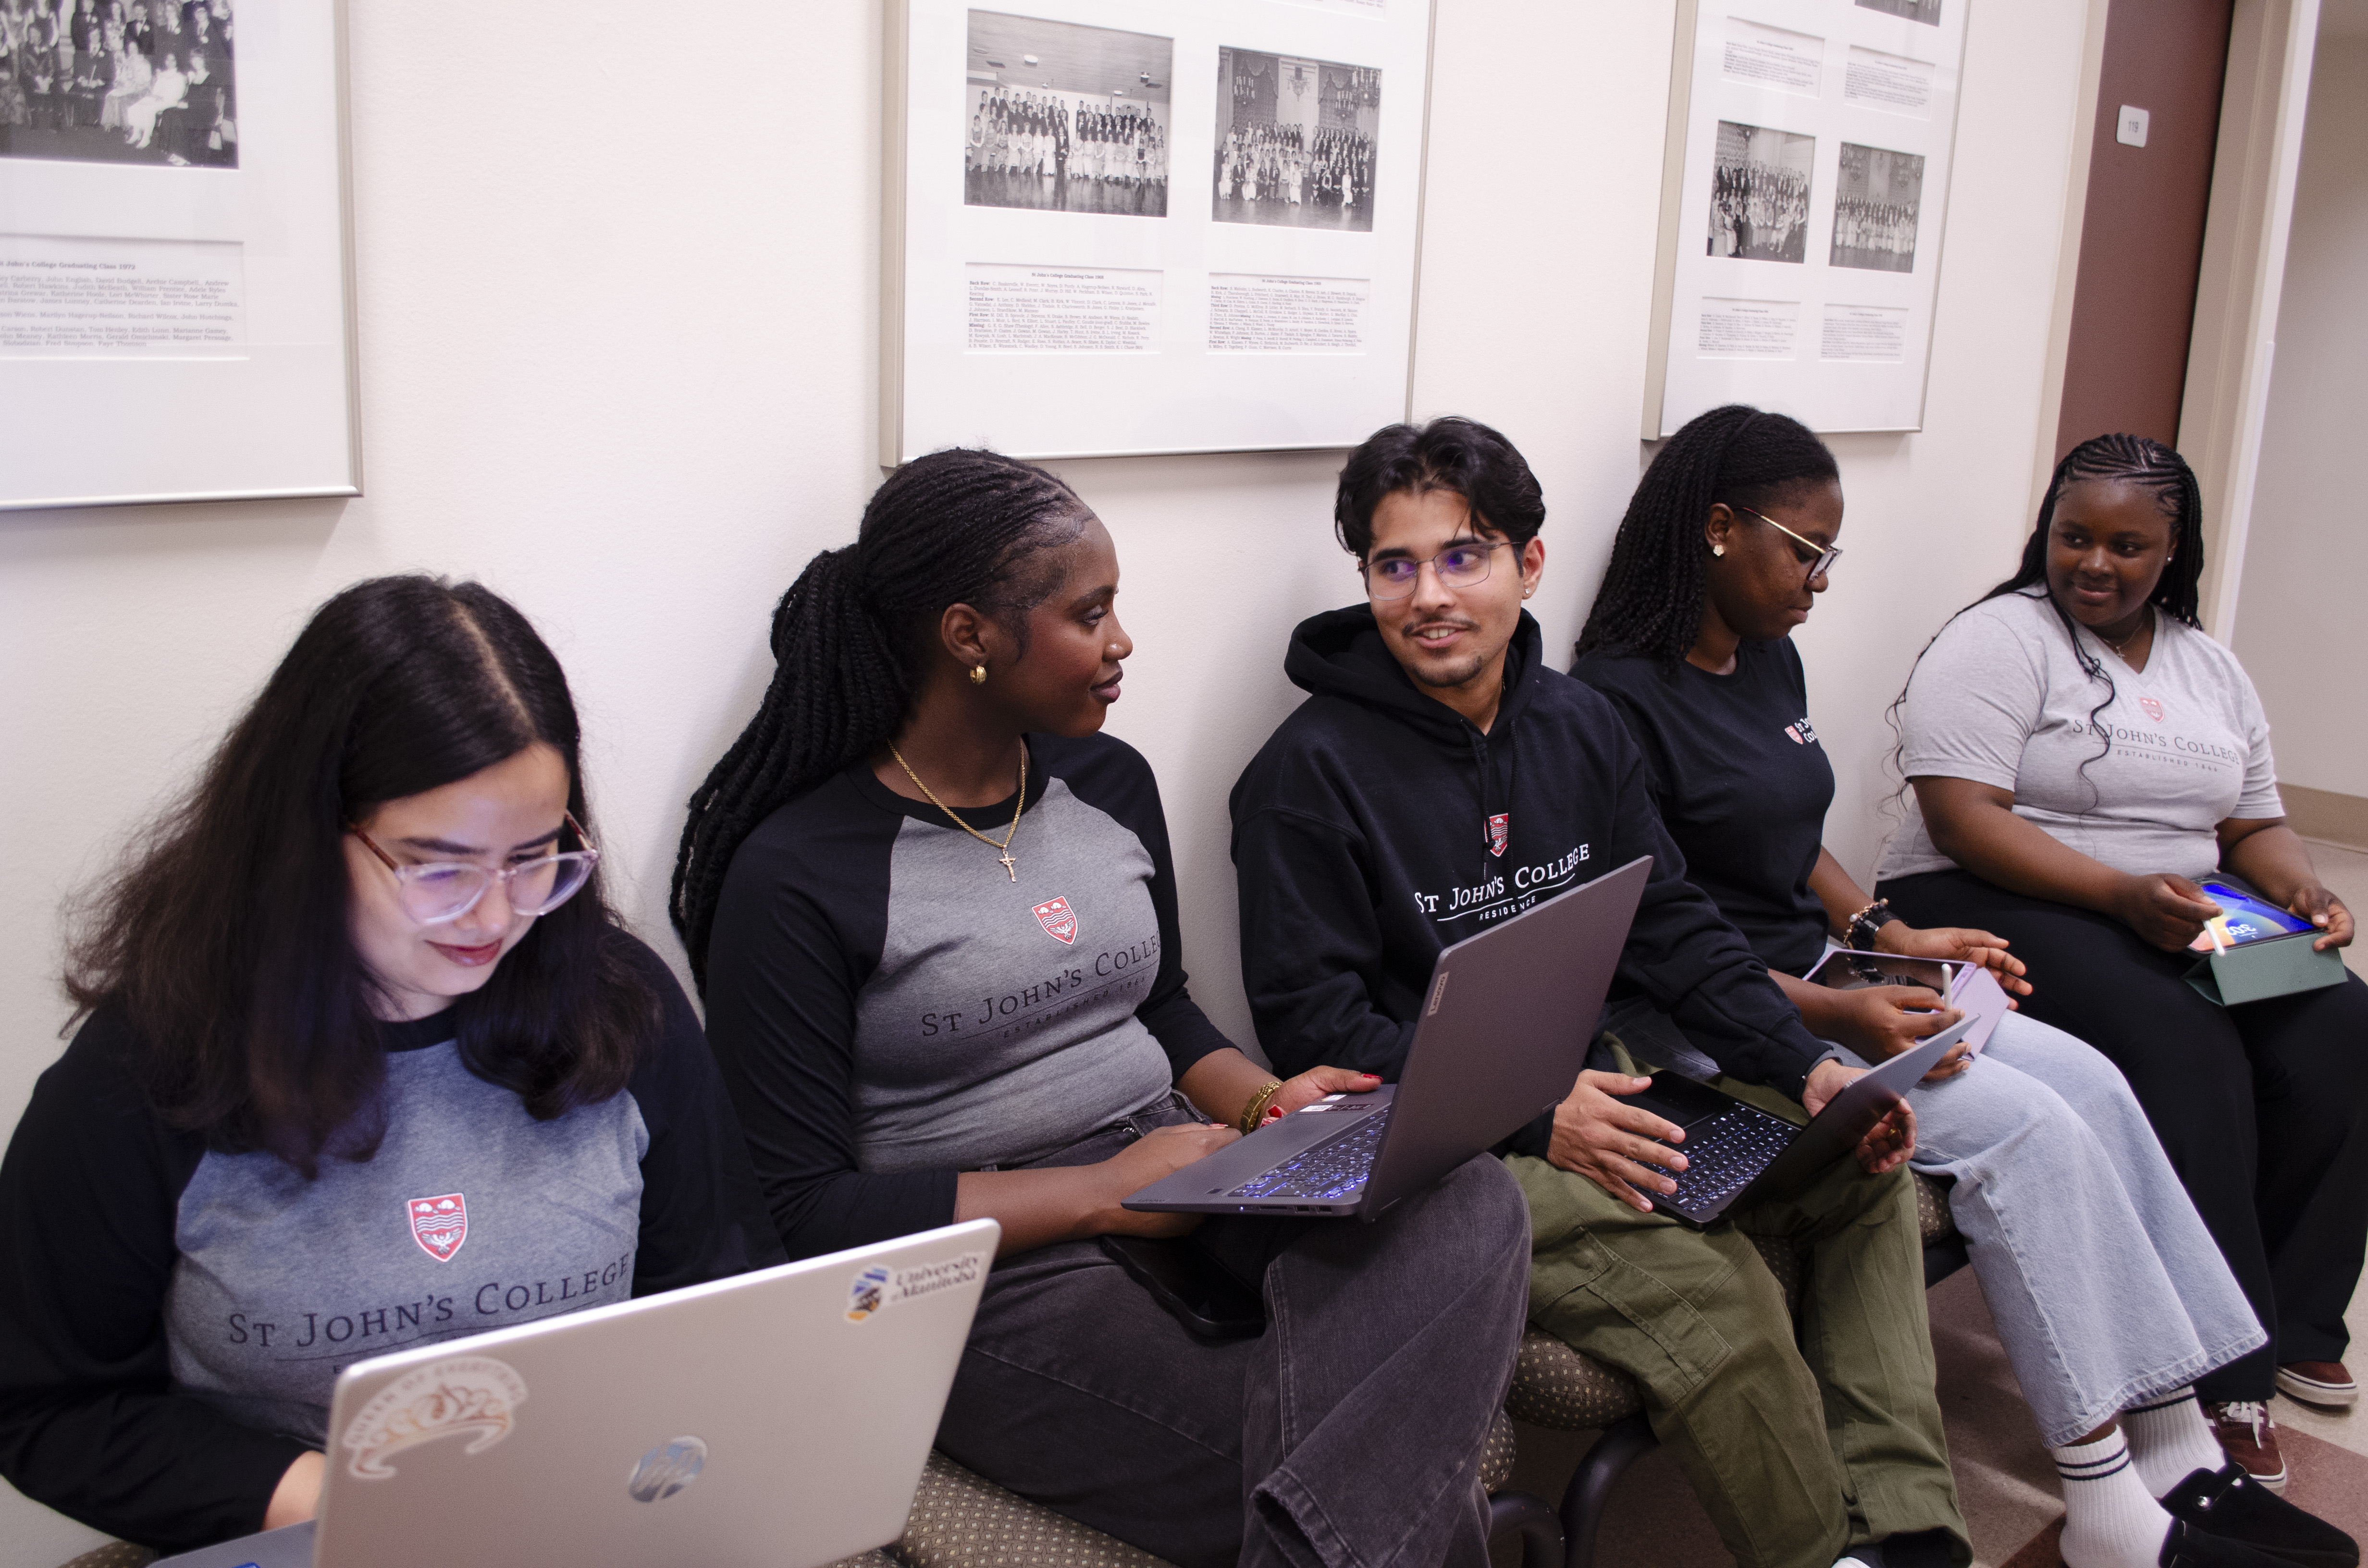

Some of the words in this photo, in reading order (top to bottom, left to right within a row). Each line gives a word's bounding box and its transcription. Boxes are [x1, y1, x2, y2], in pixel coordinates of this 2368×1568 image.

[2107, 723, 2167, 747] JOHN'S
[2174, 736, 2239, 765] COLLEGE
[2117, 749, 2188, 766] ESTABLISHED
[1415, 892, 1439, 913] ST
[1449, 876, 1504, 910] JOHN'S
[1515, 844, 1590, 889] COLLEGE
[1479, 895, 1536, 921] RESIDENCE
[922, 1012, 962, 1037] ST
[978, 969, 1082, 1025] JOHN'S
[1095, 930, 1161, 977] COLLE
[1003, 990, 1109, 1039] ESTABLISHED
[229, 1313, 276, 1347] ST
[296, 1294, 454, 1348] JOHN'S
[474, 1253, 630, 1315] COLLEGE
